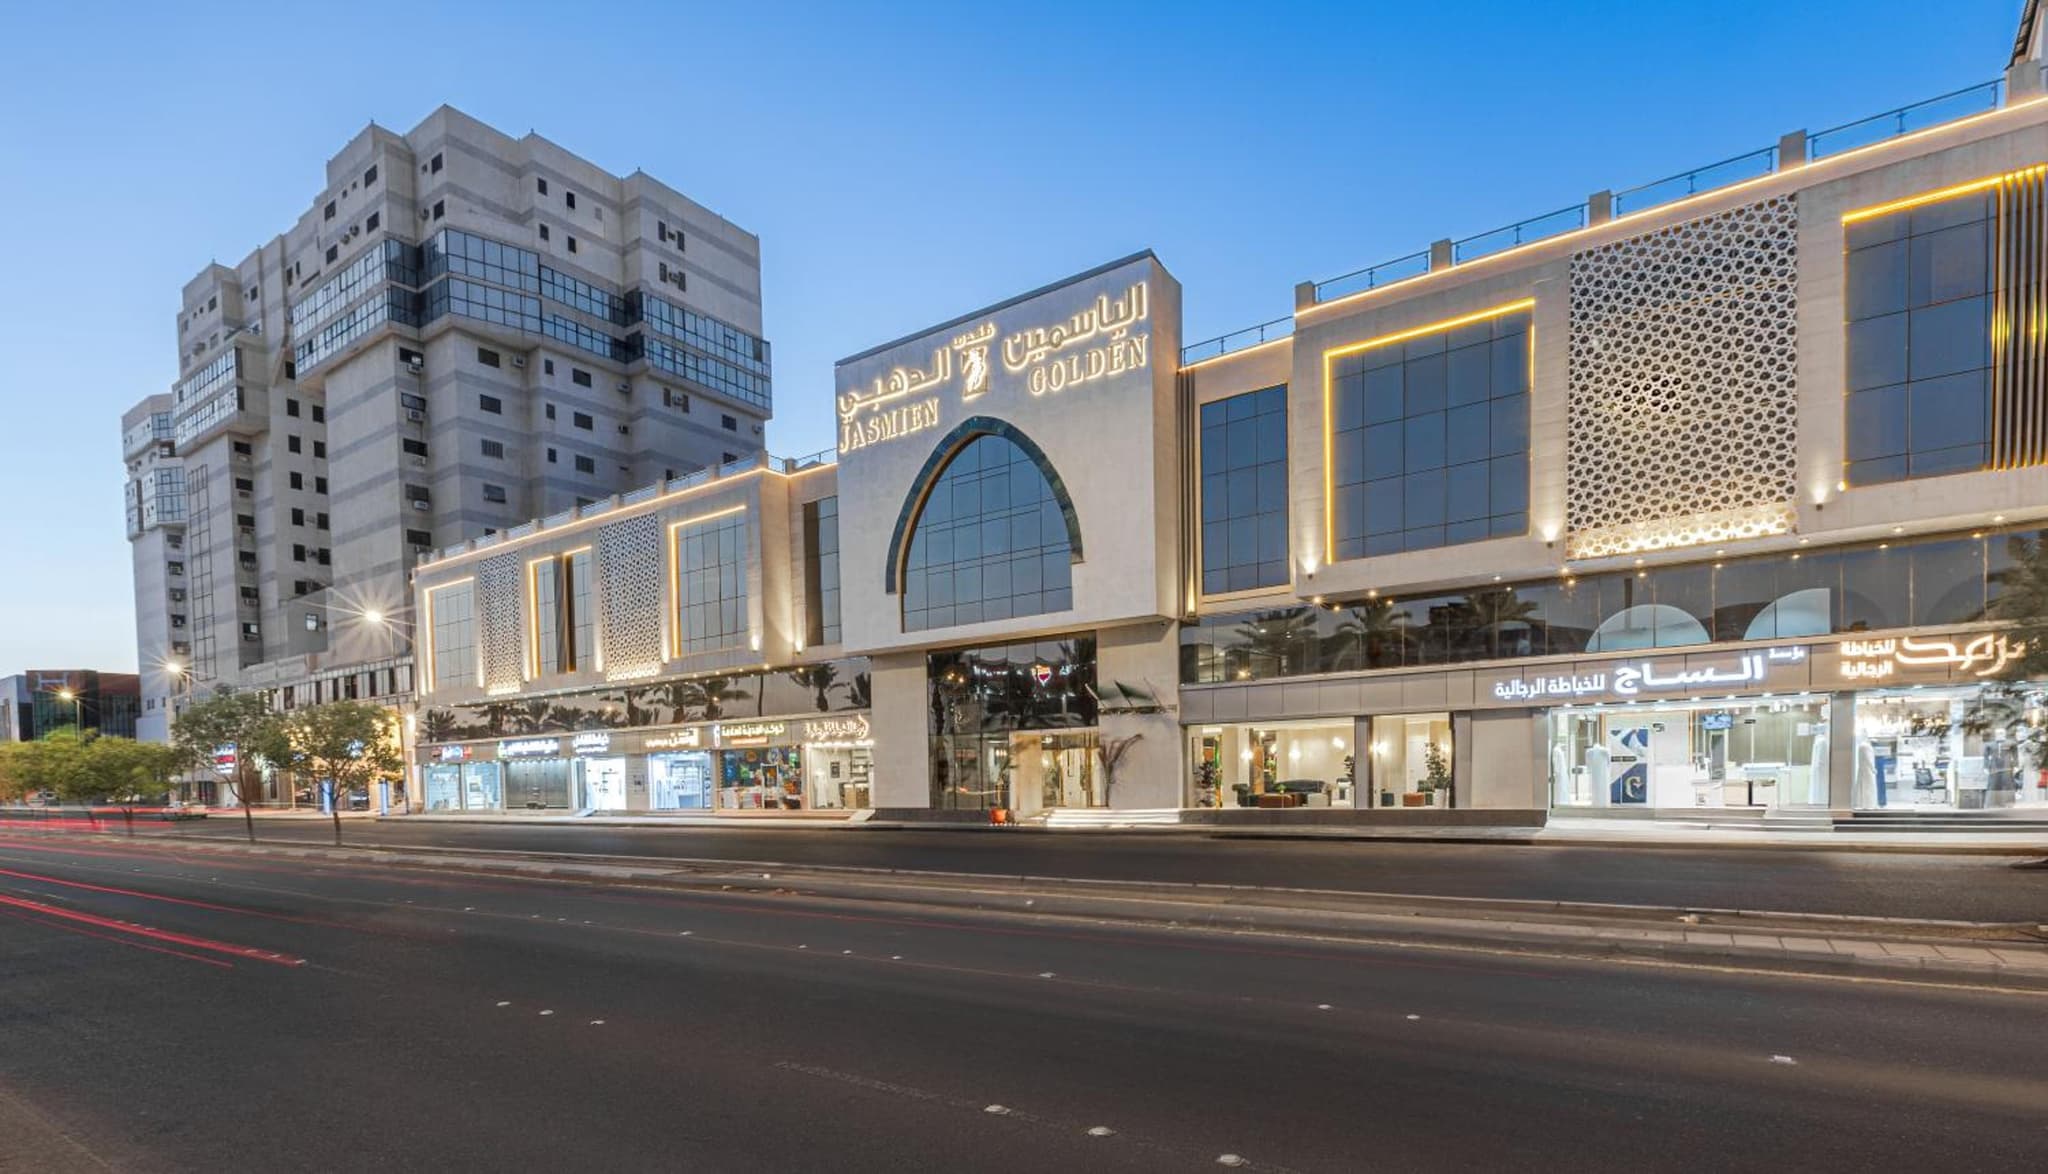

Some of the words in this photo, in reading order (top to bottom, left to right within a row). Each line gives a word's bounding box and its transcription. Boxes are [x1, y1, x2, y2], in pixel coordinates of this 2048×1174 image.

[1003, 281, 1147, 369] الياسمين
[840, 398, 940, 454] JASMIEN
[1029, 334, 1148, 395] GOLDEN
[1840, 639, 1895, 657] للخياطة
[1614, 655, 1763, 693] الساج
[1840, 660, 1893, 680] الرجالية
[1495, 678, 1545, 699] الرجالية
[1548, 673, 1605, 695] للخياطة
